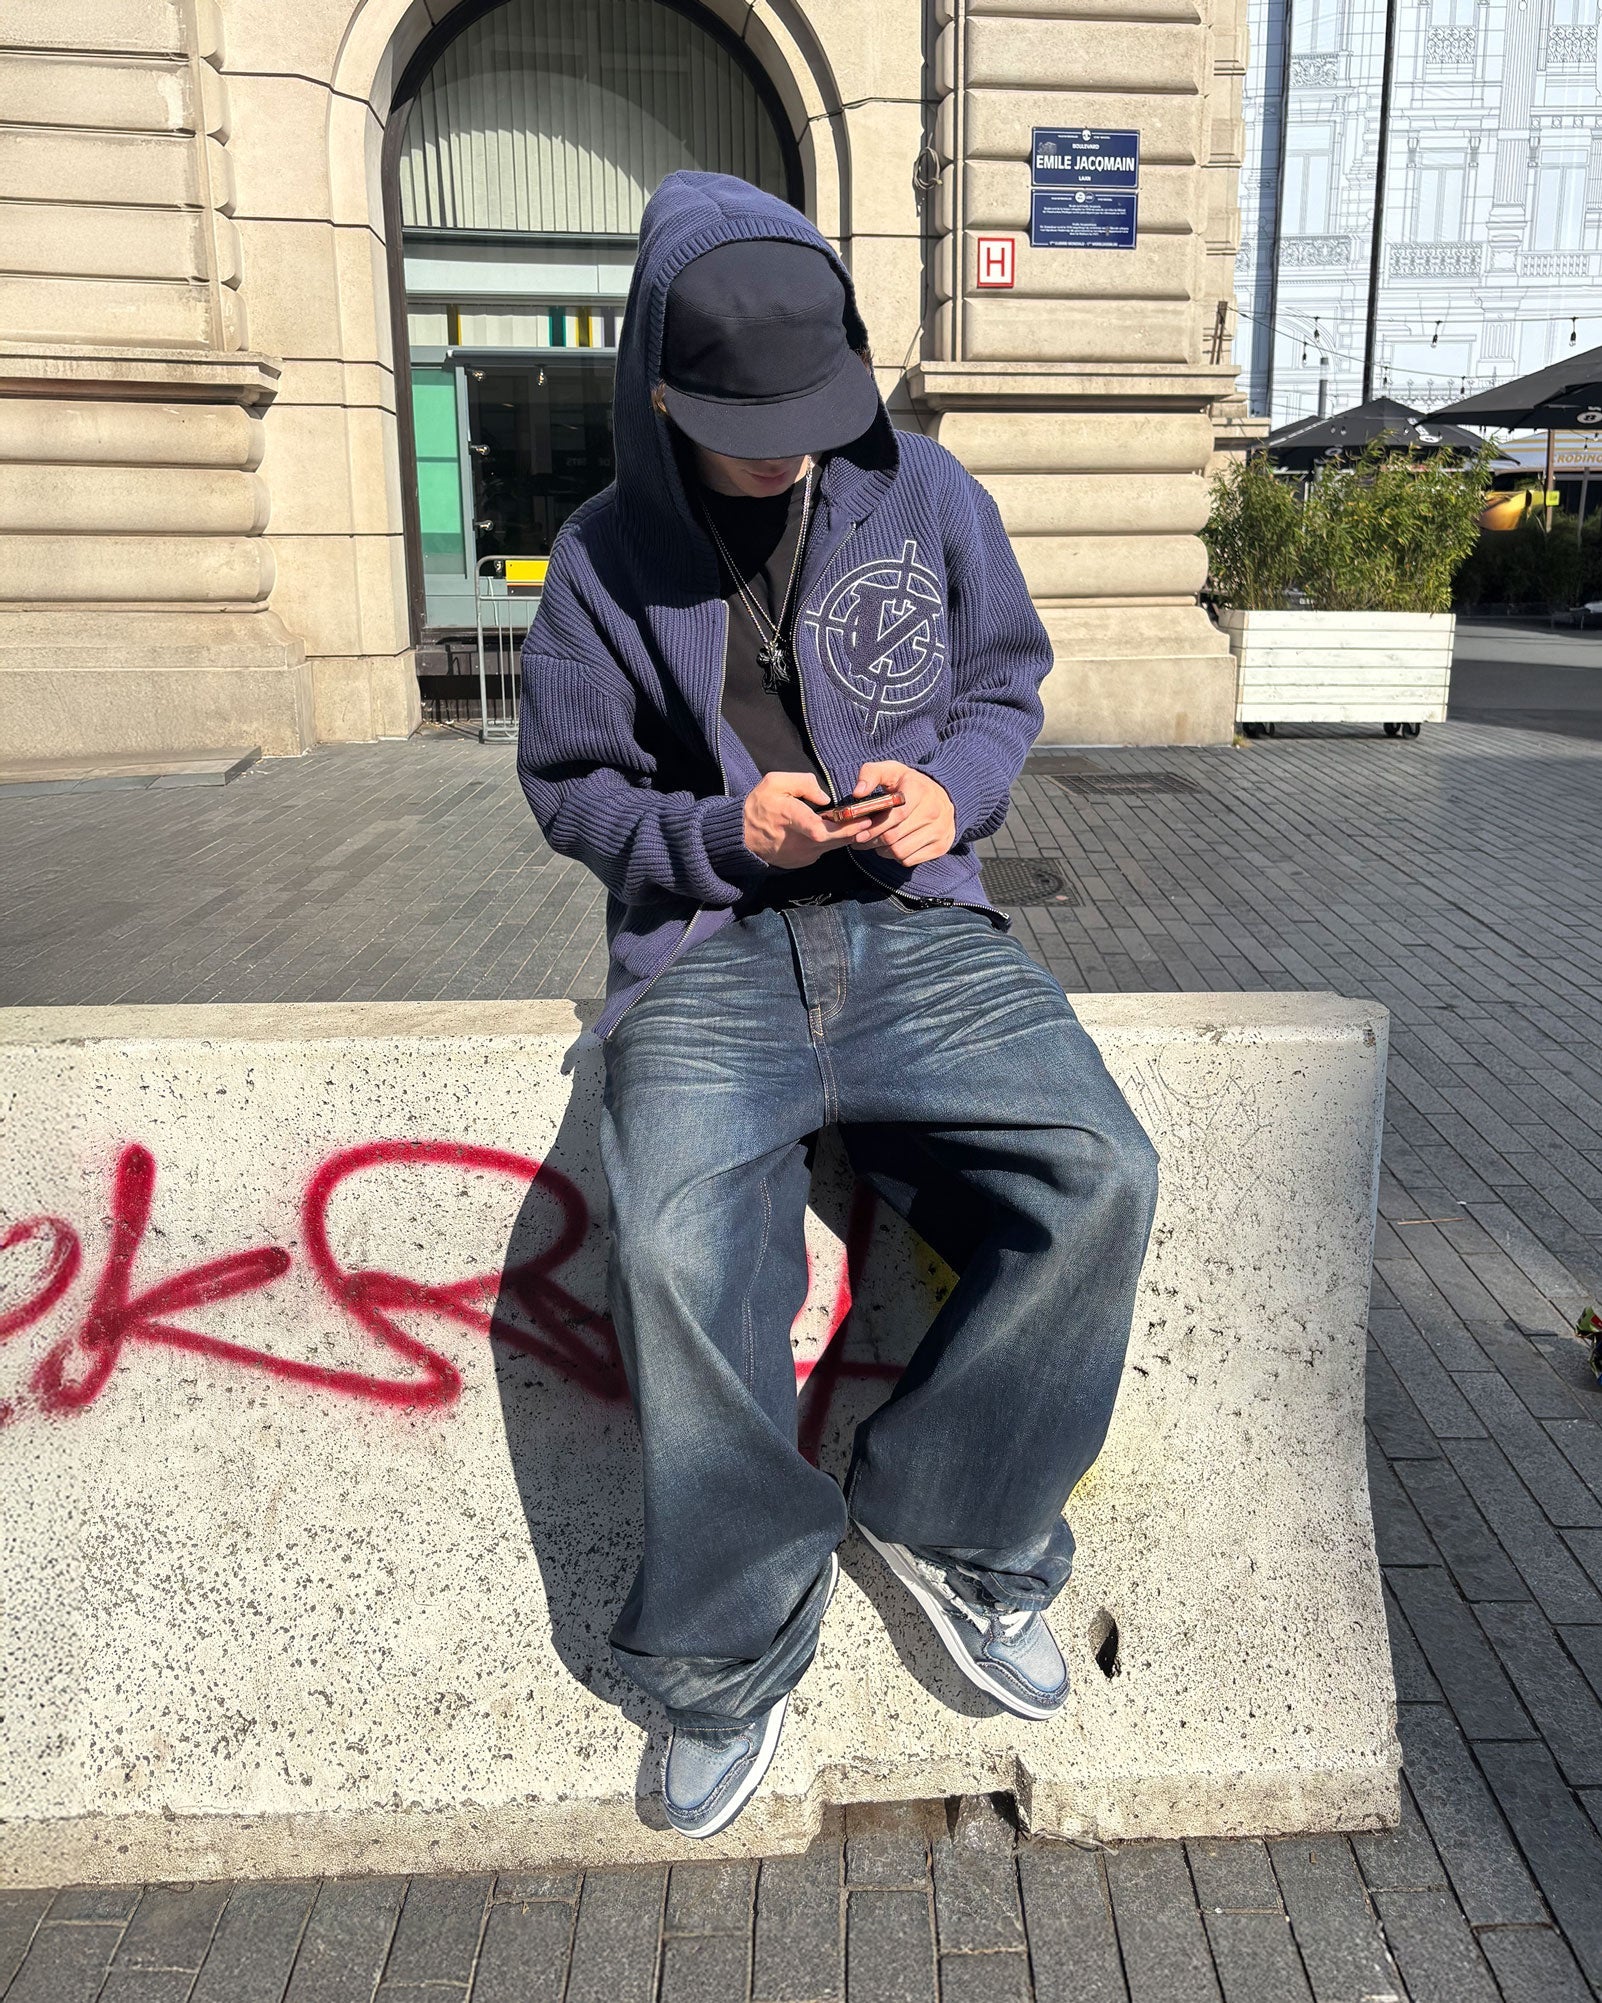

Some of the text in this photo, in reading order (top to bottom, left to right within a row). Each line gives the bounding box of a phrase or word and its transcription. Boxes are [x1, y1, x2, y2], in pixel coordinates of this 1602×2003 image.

[1036, 154, 1135, 172] EMILE JACQMAIN
[986, 247, 1005, 277] H
